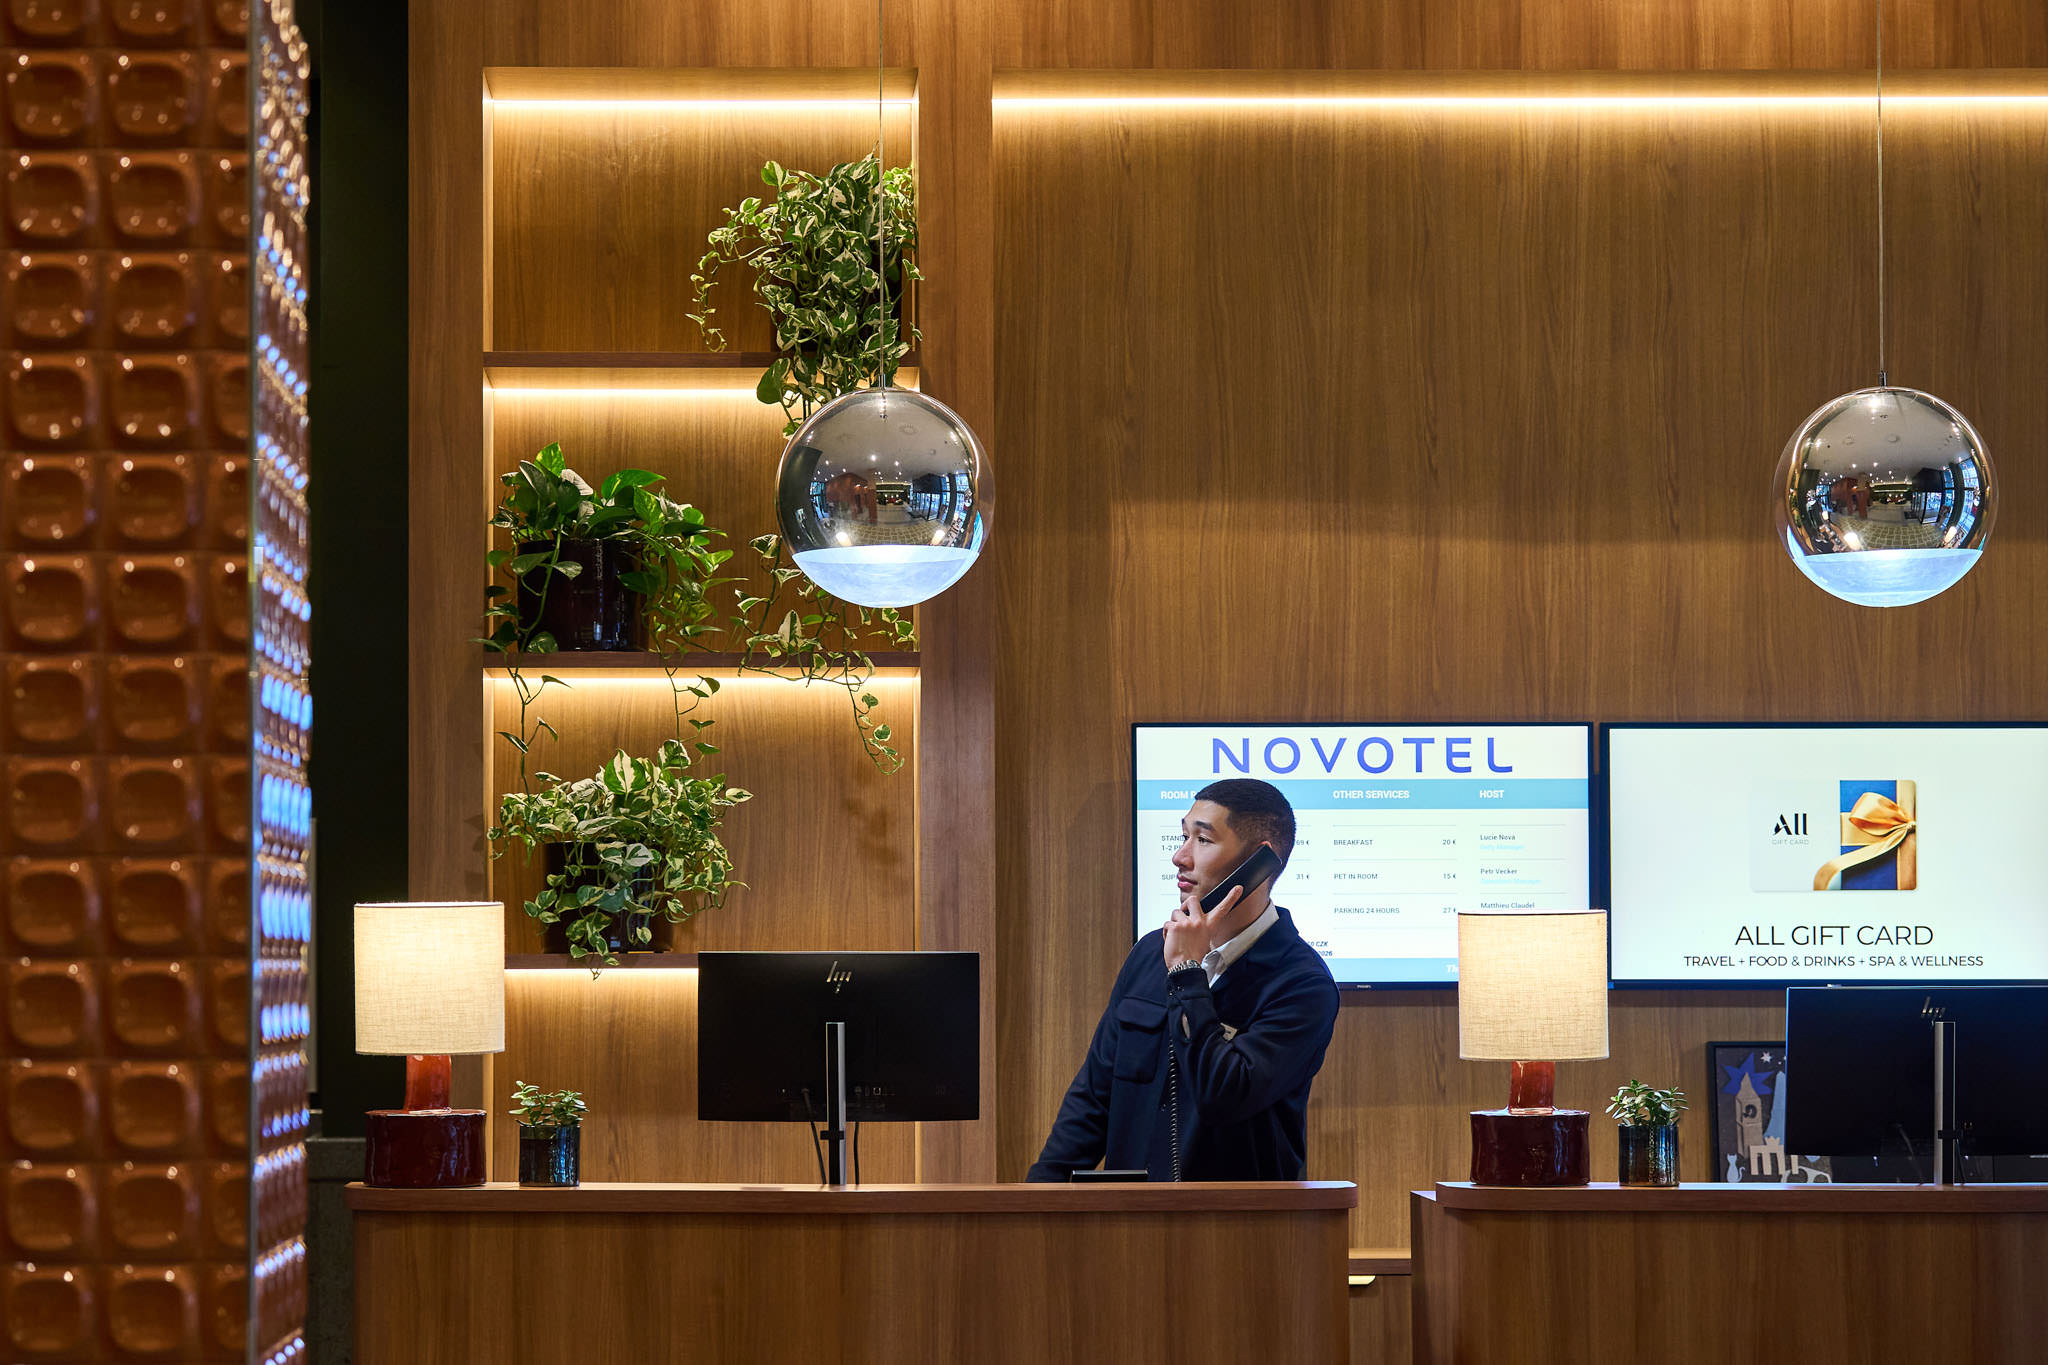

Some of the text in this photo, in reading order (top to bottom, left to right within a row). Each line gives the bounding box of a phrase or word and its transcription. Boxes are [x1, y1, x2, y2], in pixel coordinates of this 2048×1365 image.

[1213, 737, 1513, 774] NOVOTEL
[1160, 790, 1188, 799] ROOM
[1333, 790, 1410, 799] OTHER SERVICES
[1480, 790, 1504, 798] HOST
[1735, 926, 1933, 945] ALL GIFT CARD
[1684, 956, 1735, 966] TRAVEL
[1749, 956, 1788, 966] FOOD
[1791, 956, 1800, 966] &
[1804, 956, 1855, 966] DRINKS
[1869, 956, 1895, 966] SPA
[1899, 956, 1907, 966] &
[1911, 956, 1984, 966] WELLNESS
